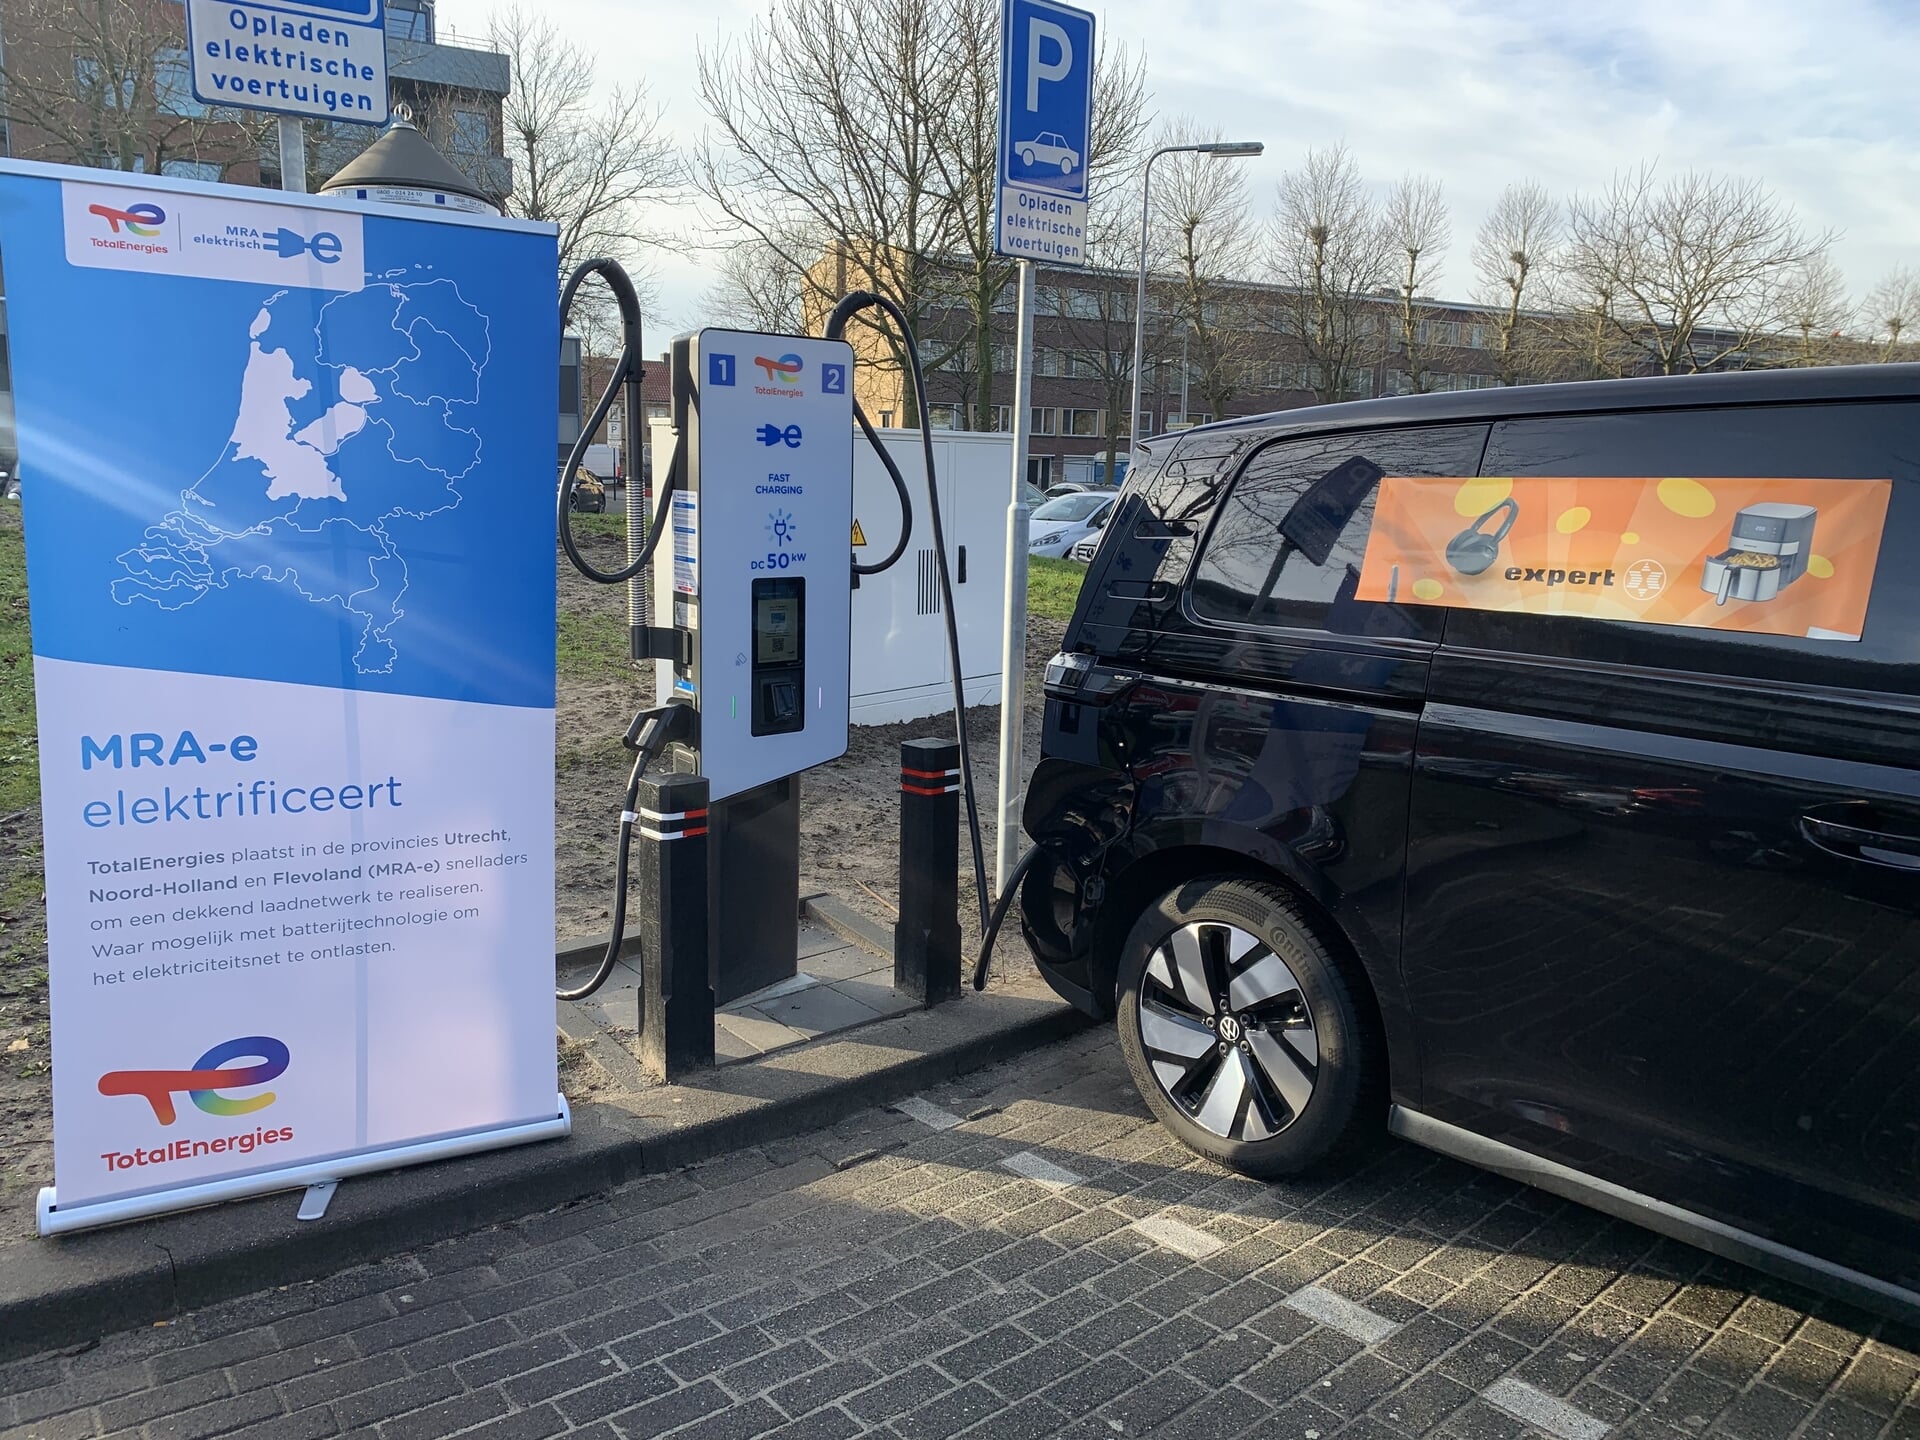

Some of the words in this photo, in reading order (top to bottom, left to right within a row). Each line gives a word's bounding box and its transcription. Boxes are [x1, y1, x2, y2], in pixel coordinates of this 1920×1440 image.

[230, 9, 349, 47] Opladen
[206, 39, 374, 81] elektrische
[1026, 16, 1073, 113] P
[212, 73, 372, 111] voertuigen
[1019, 193, 1071, 216] Opladen
[226, 225, 259, 238] MRA
[1007, 213, 1081, 237] elektrische
[90, 237, 168, 254] TotalEnergies
[194, 235, 260, 250] elektrisch
[1008, 234, 1079, 258] voertuigen
[717, 359, 727, 381] 1
[827, 368, 840, 390] 2
[754, 386, 804, 398] TotalEnergies
[768, 473, 790, 482] FAST
[755, 485, 803, 495] CHARGING
[751, 560, 765, 569] DC
[767, 553, 789, 569] 50
[791, 553, 807, 562] kW
[1504, 567, 1615, 586] expert
[81, 730, 258, 770] MRA-e
[83, 776, 402, 828] elektrificeert
[87, 852, 225, 875] TotalEnergies
[232, 845, 295, 864] plaatst
[301, 843, 316, 857] in
[322, 842, 345, 855] de
[351, 836, 439, 856] provincies
[445, 829, 511, 845] Utrecht,
[89, 875, 238, 903] Noord-Holland
[244, 875, 266, 888] en
[273, 866, 362, 885] Flevoland
[368, 859, 441, 879] (MRA-e)
[446, 853, 528, 871] snelladers
[90, 918, 122, 931] om
[130, 913, 165, 927] een
[172, 901, 254, 922] dekkend
[260, 891, 371, 913] laadnetwerk
[377, 889, 393, 902] te
[399, 882, 483, 900] realiseren.
[91, 942, 145, 958] Waar
[151, 930, 233, 950] mogelijk
[240, 926, 276, 941] met
[282, 910, 448, 937] batterijtechnologie
[453, 907, 479, 920] om
[93, 970, 126, 986] het
[132, 952, 281, 981] elektriciteitsnet
[287, 950, 305, 963] te
[310, 941, 396, 961] ontlasten.
[101, 1127, 293, 1172] TotalEnergies
